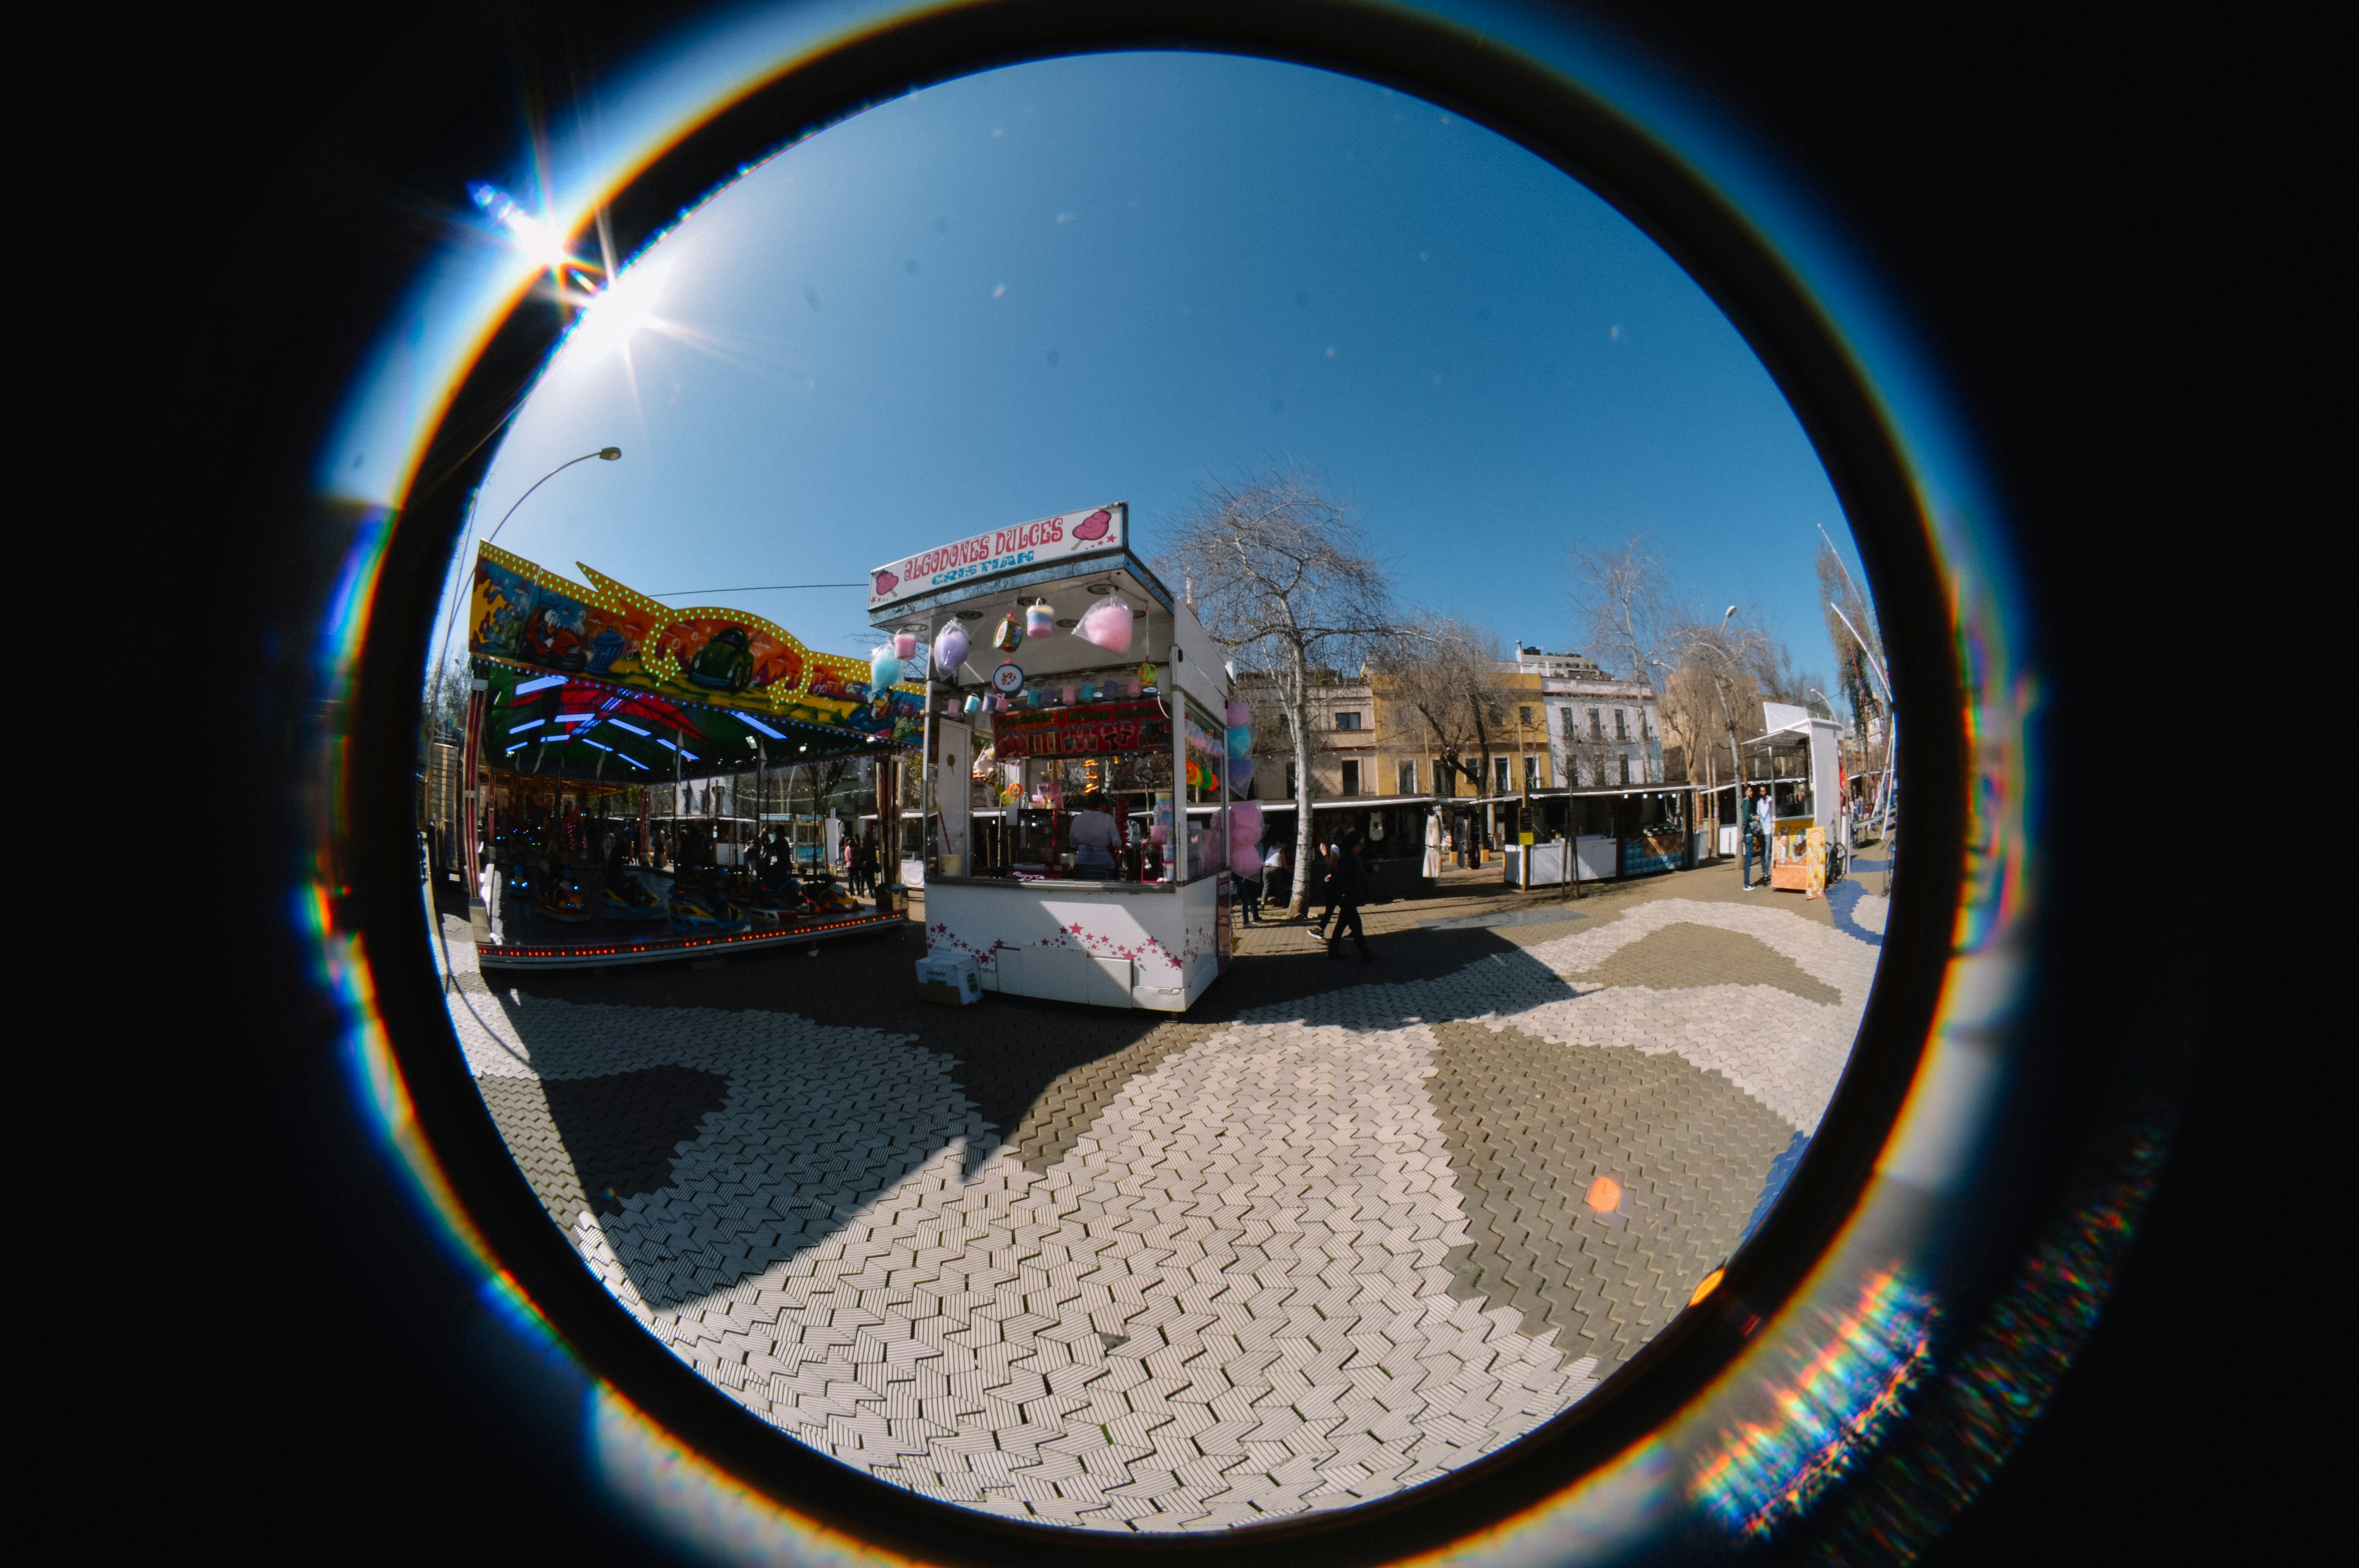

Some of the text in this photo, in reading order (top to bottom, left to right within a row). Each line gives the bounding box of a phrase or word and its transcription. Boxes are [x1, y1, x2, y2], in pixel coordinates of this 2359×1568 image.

[904, 518, 1063, 582] ALGODONES DULCES
[932, 550, 1034, 585] CRISTIAN
